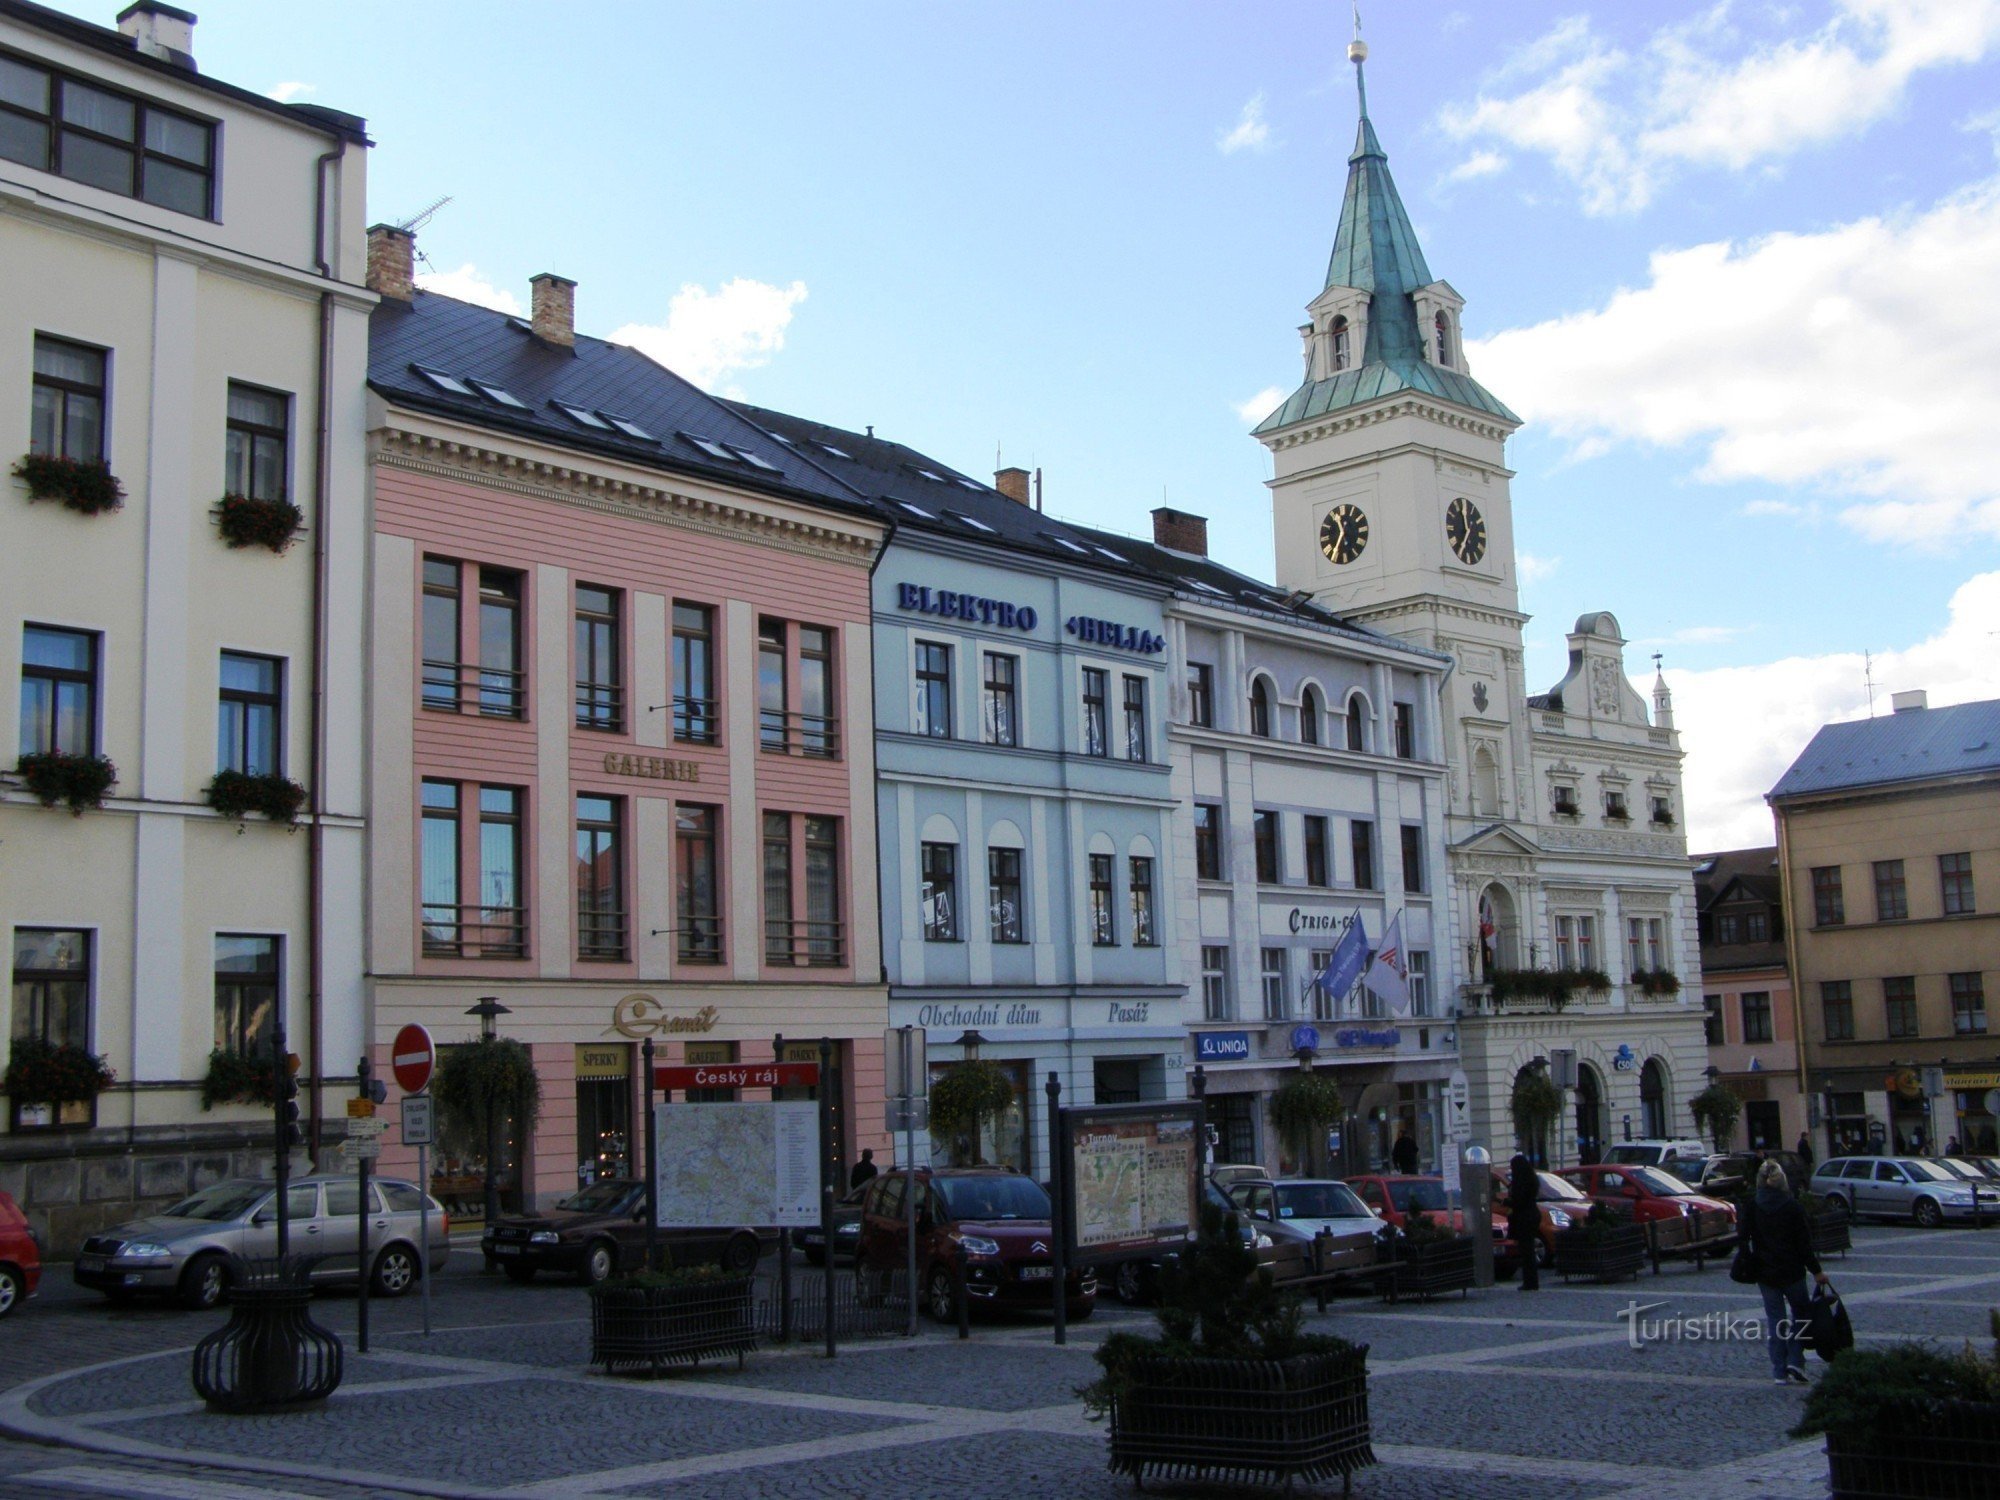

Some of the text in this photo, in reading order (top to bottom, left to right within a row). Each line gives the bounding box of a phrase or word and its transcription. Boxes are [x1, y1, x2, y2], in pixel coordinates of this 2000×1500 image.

[898, 582, 1038, 632] ELEKTRO
[1078, 616, 1157, 655] HELIA
[604, 752, 698, 783] GALERIE
[599, 992, 721, 1039] Granát
[918, 1002, 1150, 1027] Obchodní dům Pasáž
[583, 1050, 618, 1067] ŠPERKY
[1216, 1038, 1248, 1055] UNIQA
[695, 1068, 779, 1085] Český ráj
[1088, 1133, 1118, 1144] Turnov
